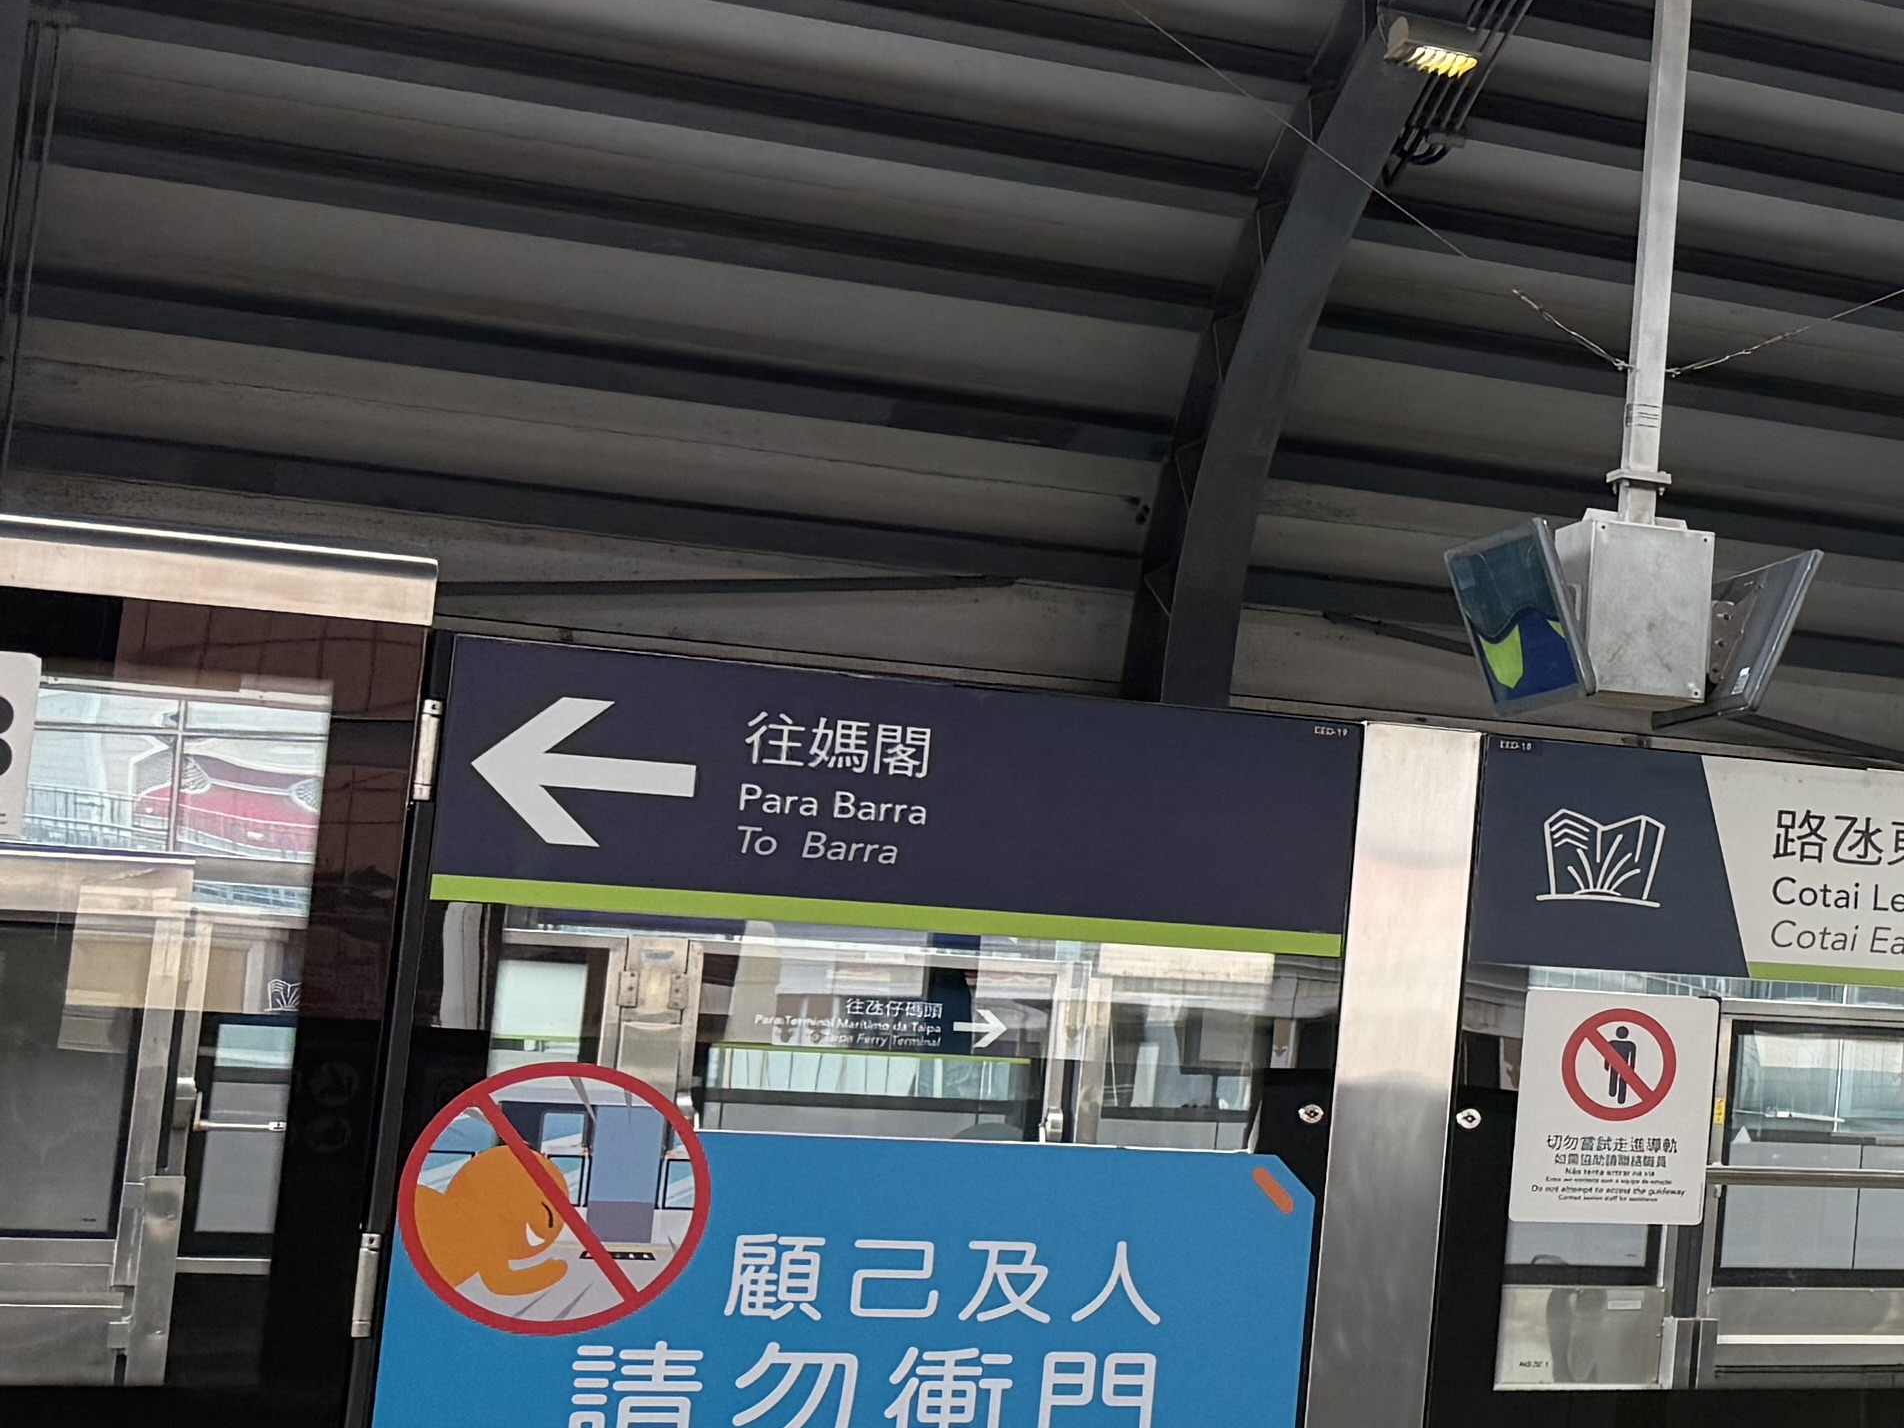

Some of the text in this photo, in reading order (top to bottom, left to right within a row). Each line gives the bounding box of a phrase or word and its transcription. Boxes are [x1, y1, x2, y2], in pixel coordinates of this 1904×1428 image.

[744, 710, 932, 779] 往媽閣
[738, 783, 928, 825] Para Barra
[737, 825, 899, 865] To Barra
[1772, 876, 1860, 910] Cotai
[1770, 919, 1860, 952] Cotai
[723, 1231, 1162, 1325] 顧己及人
